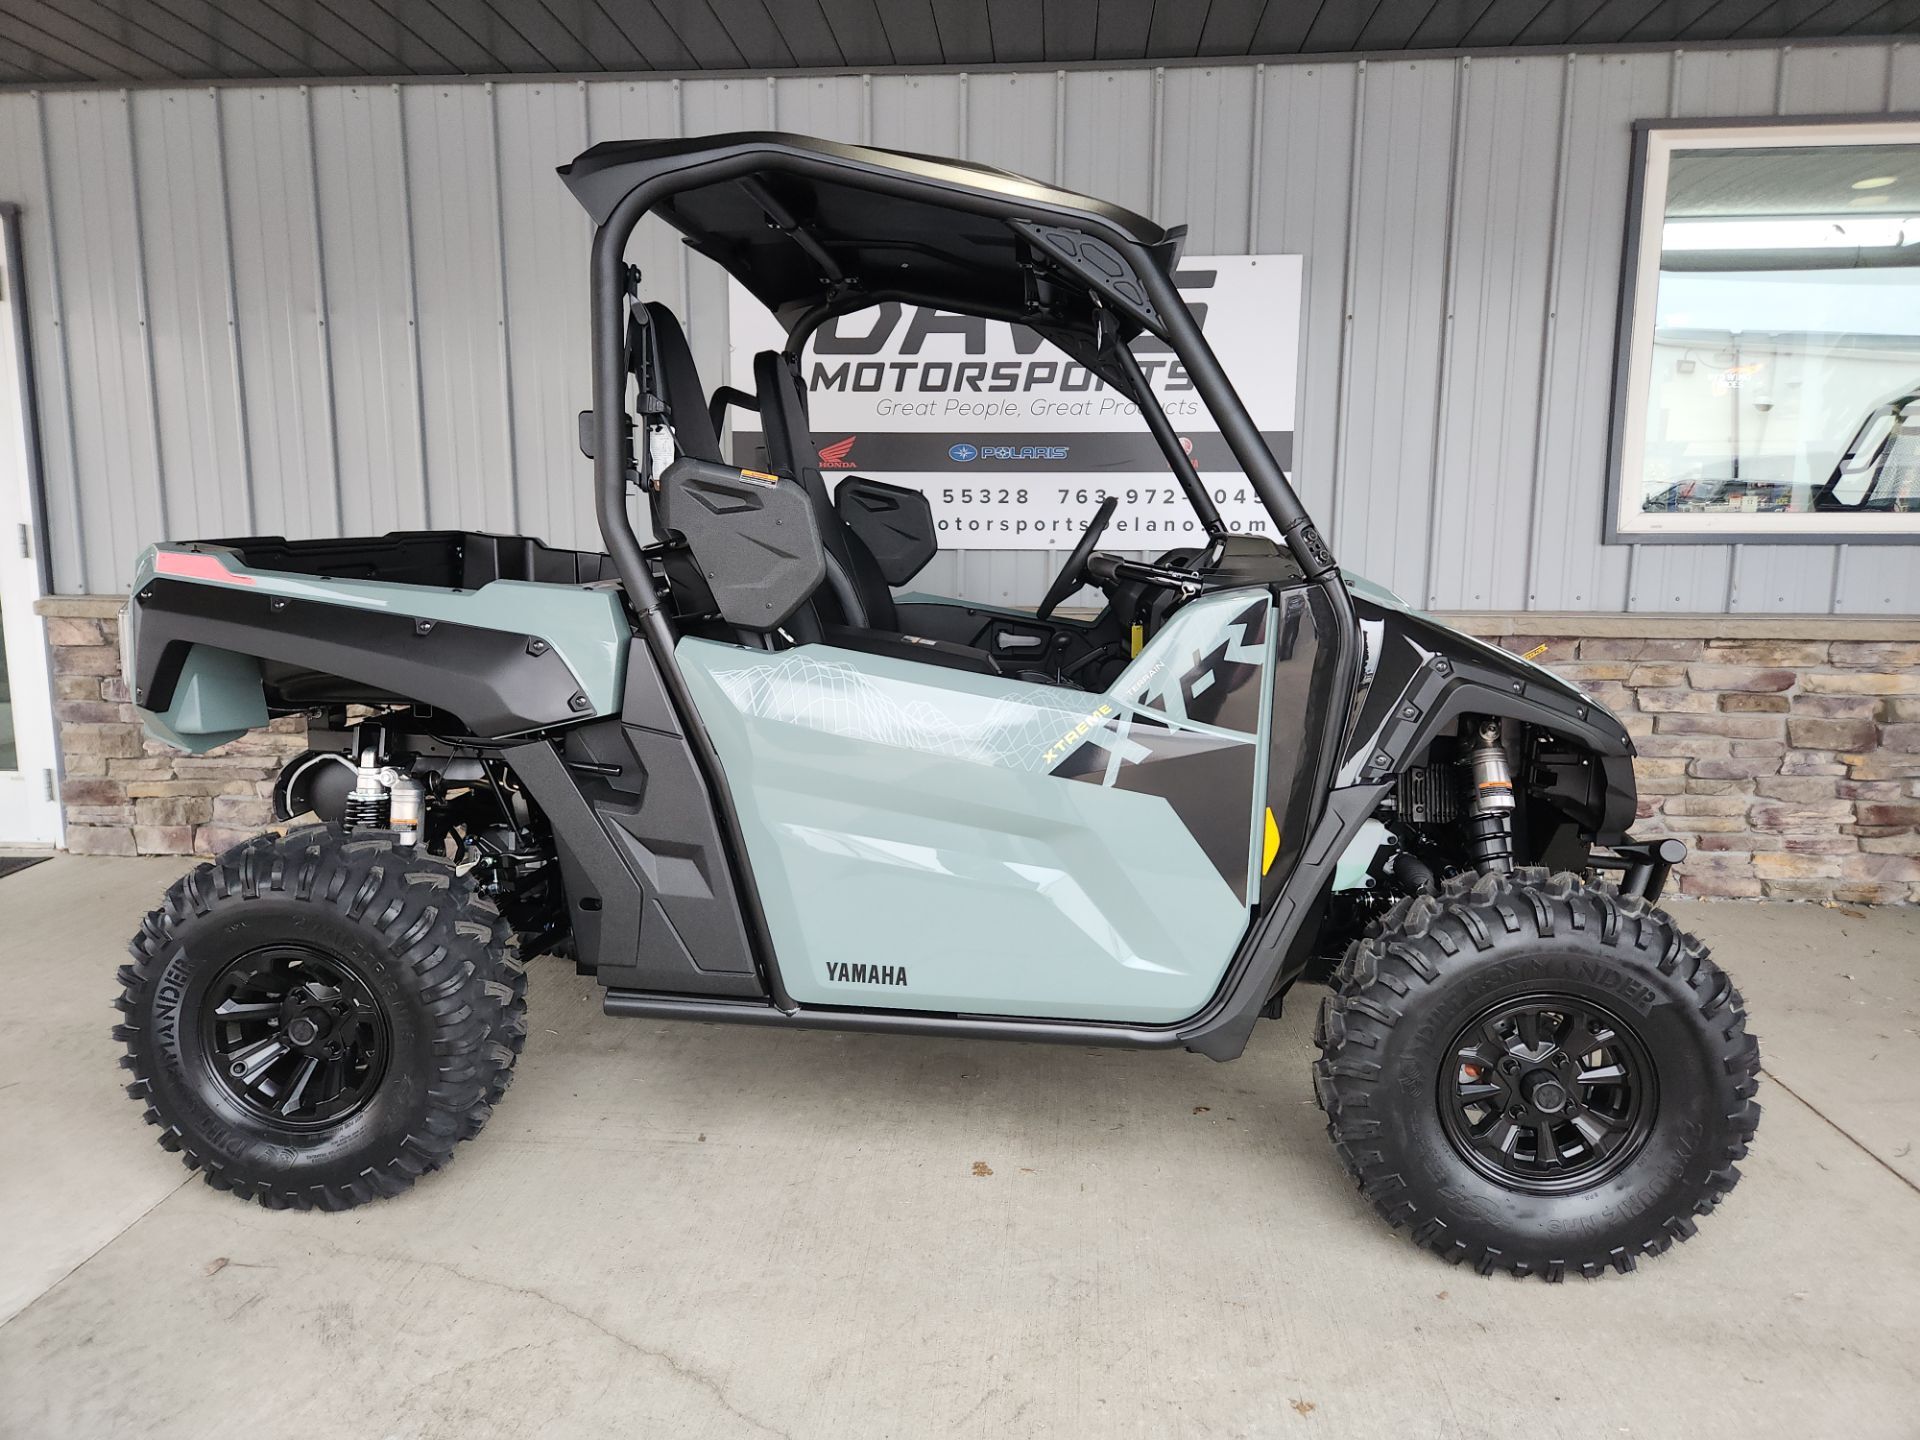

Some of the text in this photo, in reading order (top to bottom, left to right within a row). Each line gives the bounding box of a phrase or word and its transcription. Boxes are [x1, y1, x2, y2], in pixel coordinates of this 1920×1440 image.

[810, 361, 1194, 392] MOTORSPOTS
[876, 398, 937, 416] Great
[944, 398, 1021, 420] People,
[1030, 398, 1093, 416] Great
[981, 447, 1068, 459] POLARIS
[943, 489, 1028, 504] 55328
[1127, 661, 1165, 696] TERRAIN
[1042, 704, 1112, 765] XTREME
[826, 961, 907, 986] YAMAHA
